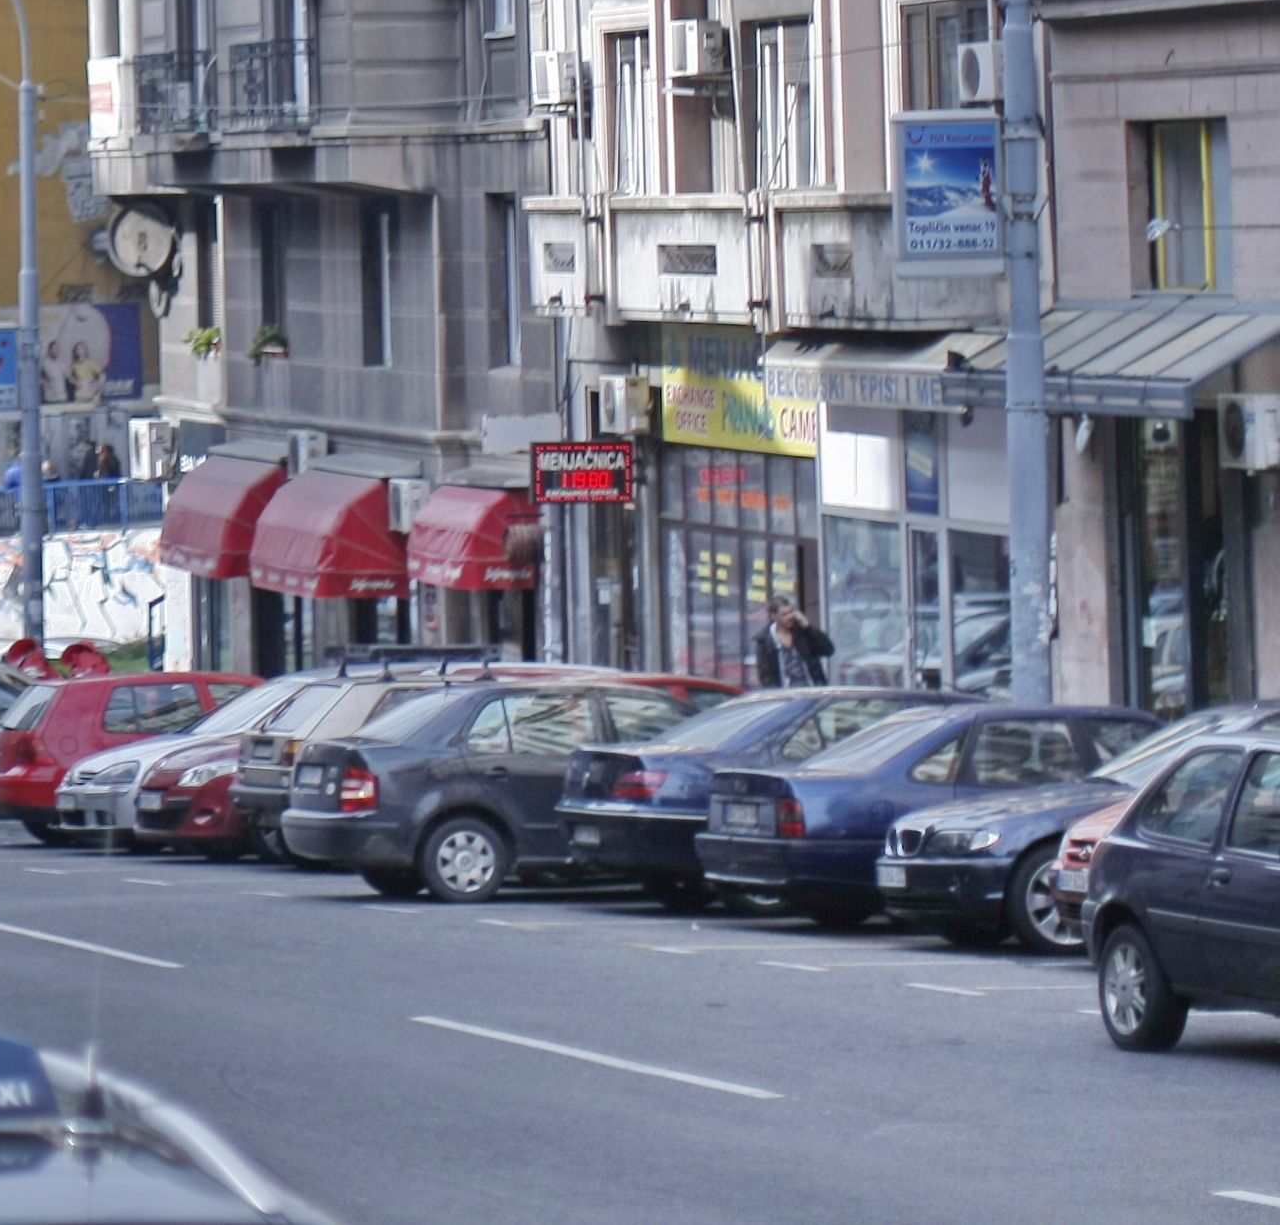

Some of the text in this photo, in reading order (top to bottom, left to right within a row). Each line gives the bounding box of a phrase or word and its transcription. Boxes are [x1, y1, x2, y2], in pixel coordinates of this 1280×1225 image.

[666, 382, 716, 411] EXCHANGE
[675, 410, 708, 435] OFFICE
[539, 448, 625, 471] MENJAČNICA
